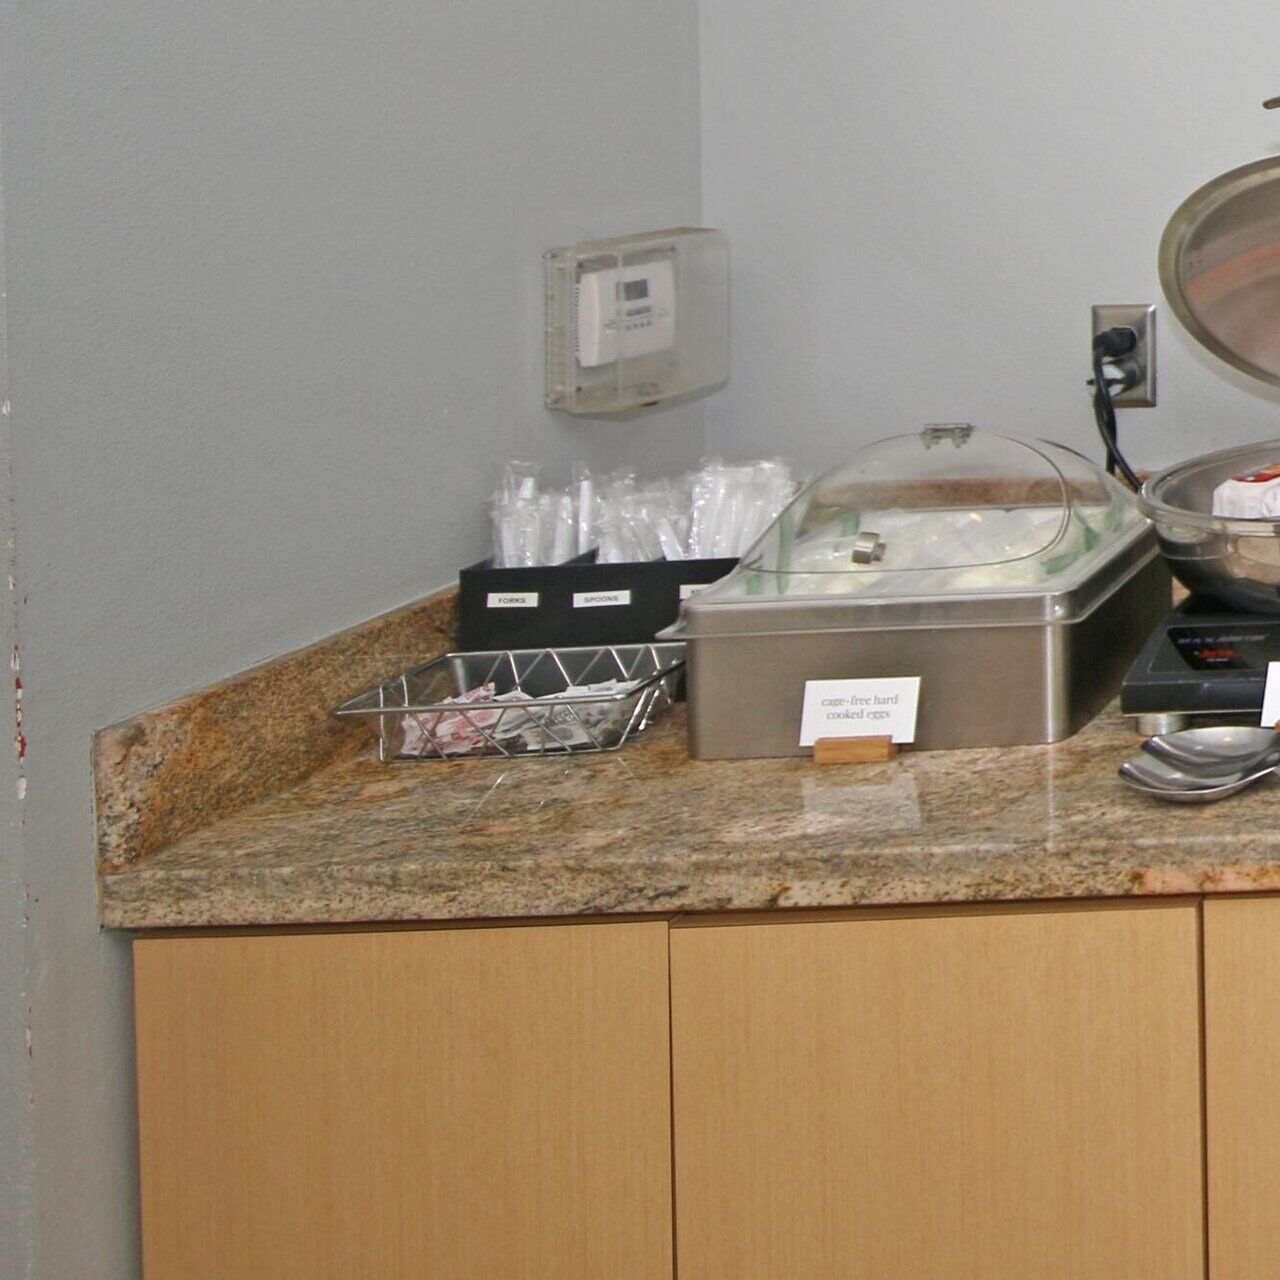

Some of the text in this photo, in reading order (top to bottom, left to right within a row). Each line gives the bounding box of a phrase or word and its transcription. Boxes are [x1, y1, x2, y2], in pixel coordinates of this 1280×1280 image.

[583, 595, 619, 603] SPOONS
[821, 693, 899, 708] cage-free hard
[826, 709, 891, 721] cooked eggs
